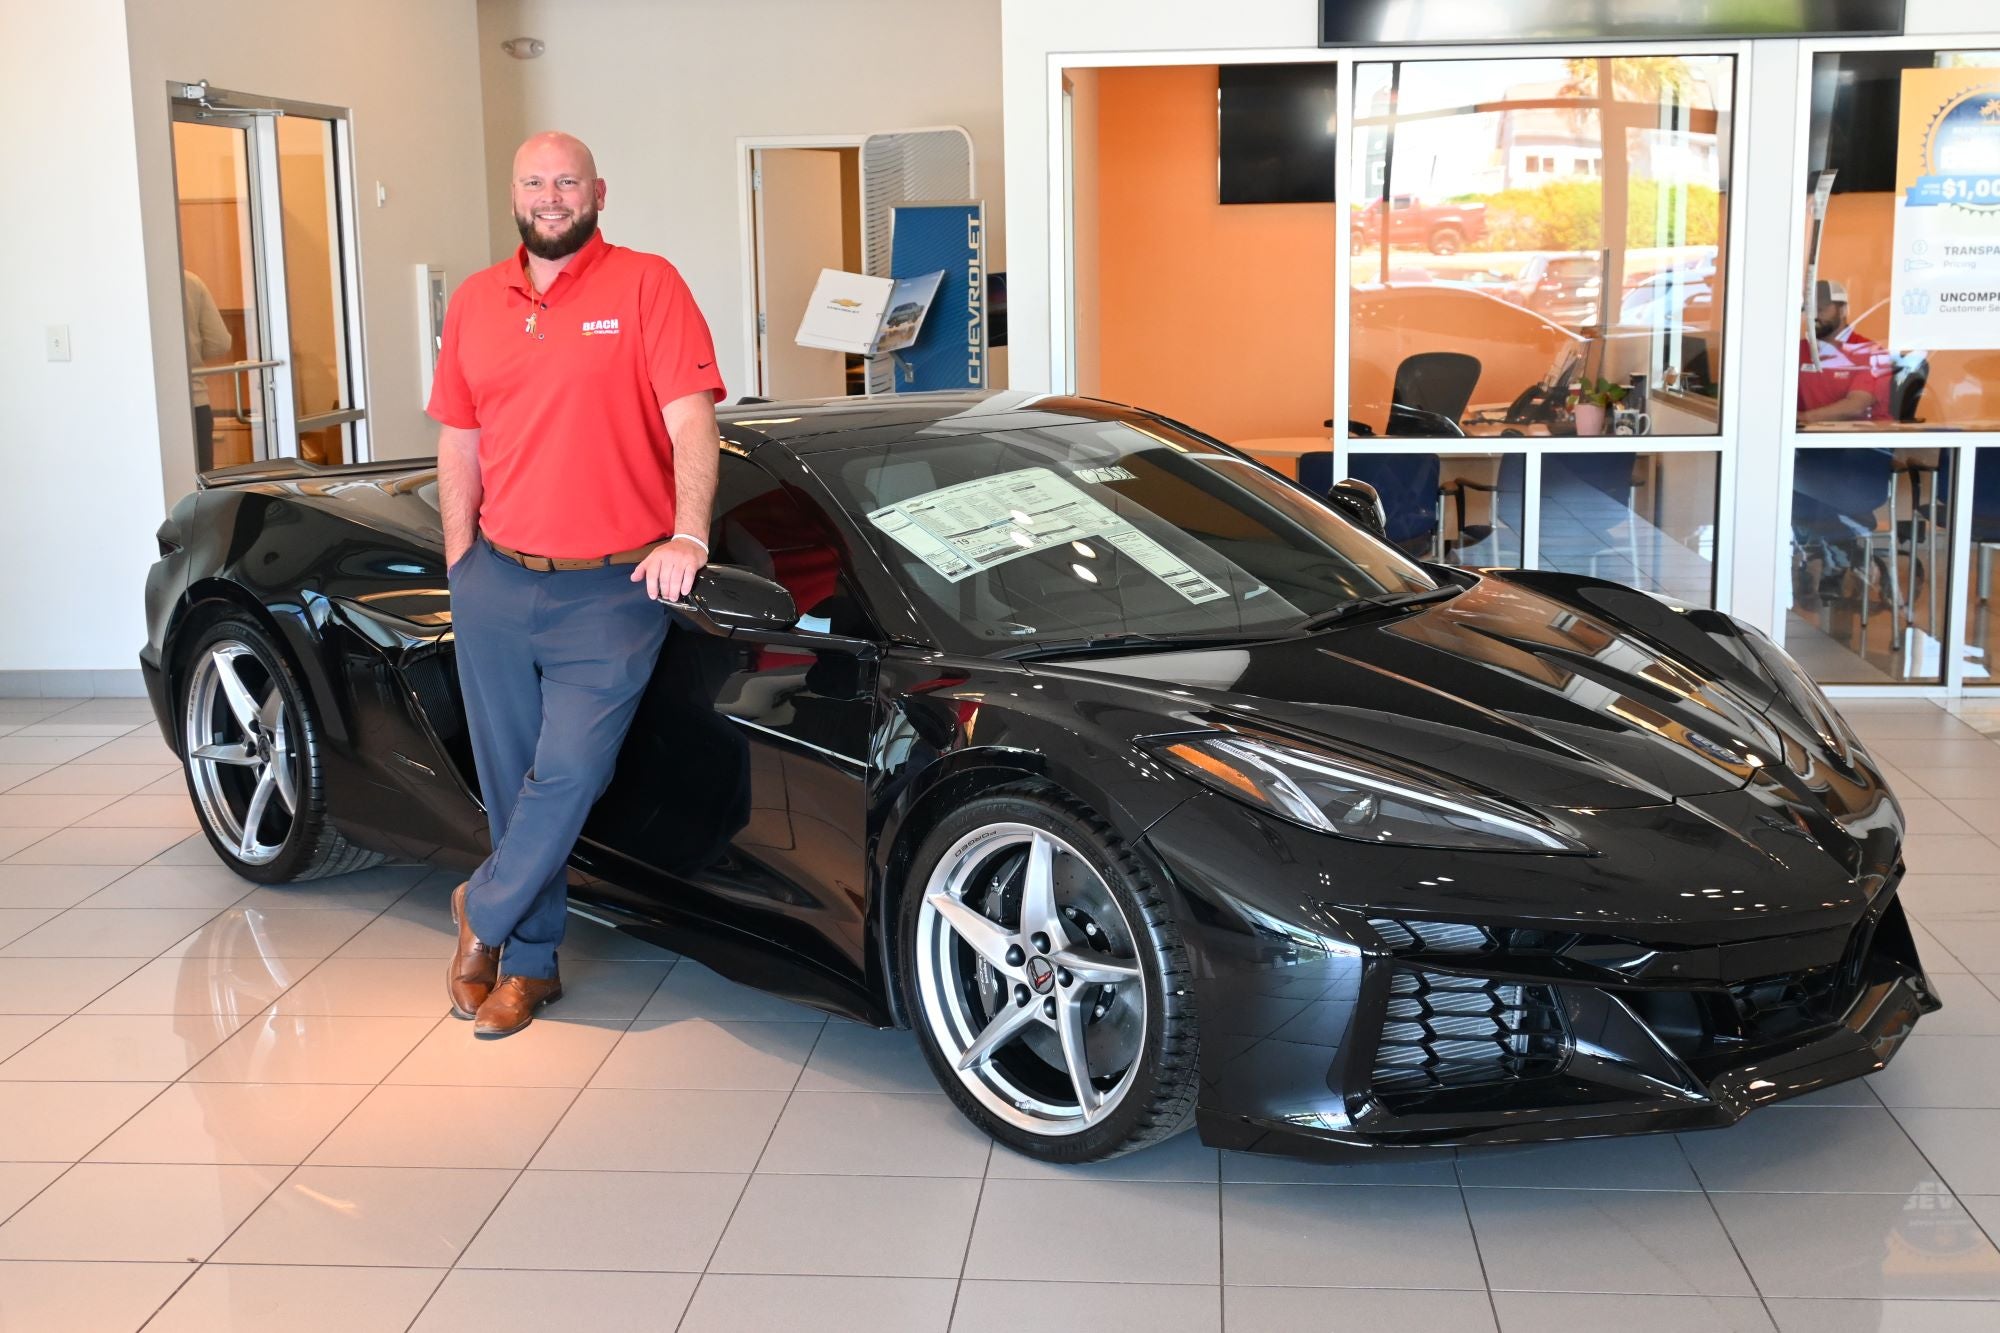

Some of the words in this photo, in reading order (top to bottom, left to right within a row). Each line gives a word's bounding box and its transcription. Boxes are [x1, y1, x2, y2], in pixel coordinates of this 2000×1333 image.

[1944, 246, 2000, 256] TRANSPA
[1943, 260, 1976, 269] Pricing
[967, 213, 981, 384] CHEVROLET
[1940, 305, 1985, 313] Customer
[582, 319, 619, 331] BEACH
[954, 830, 998, 858] FORGED
